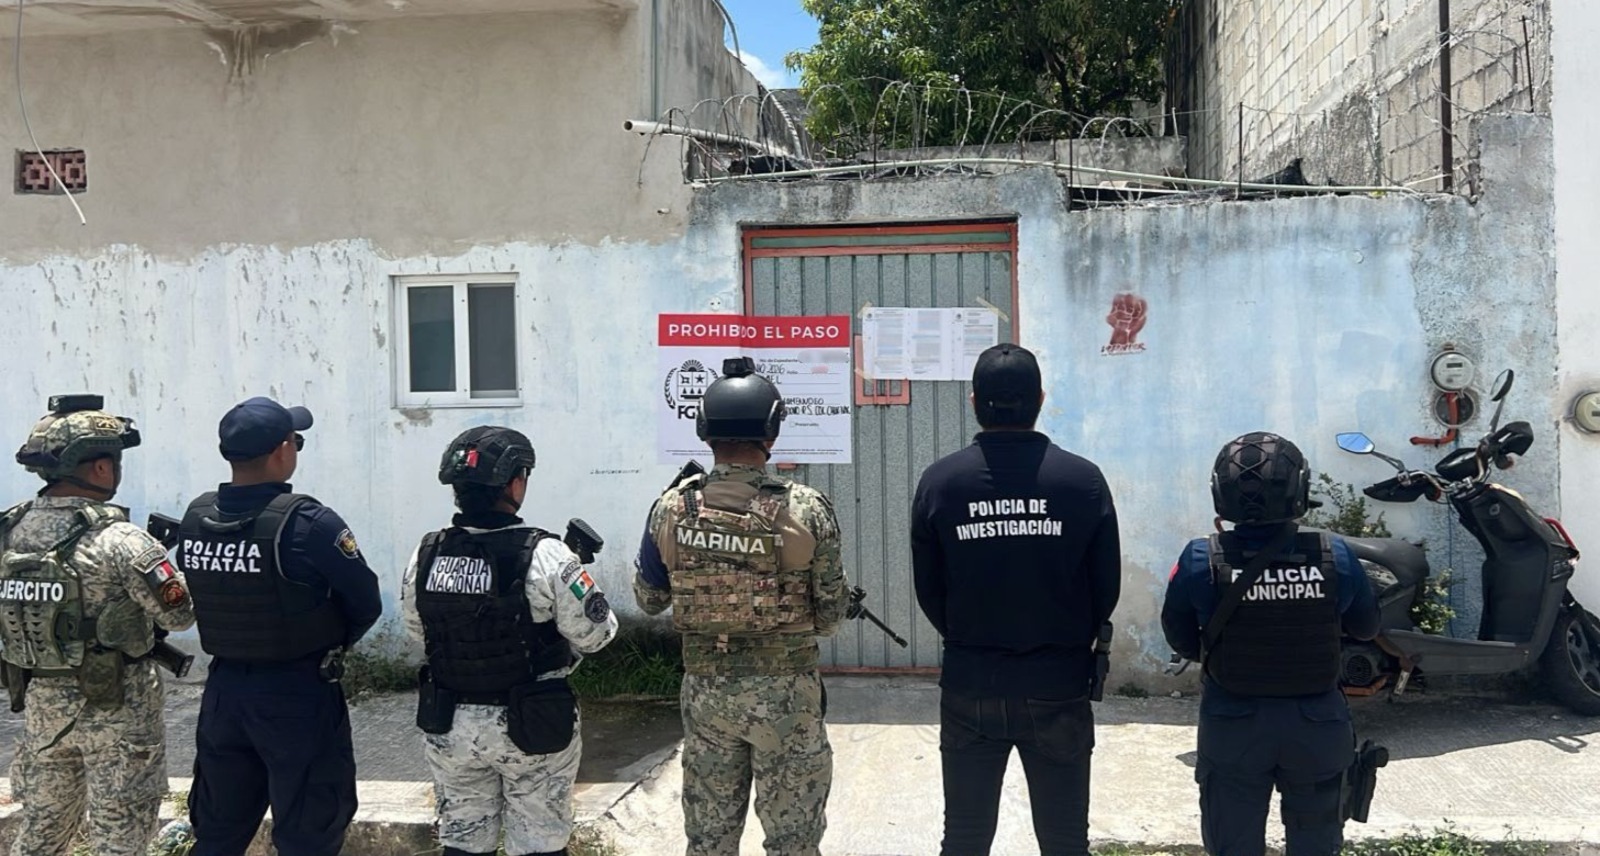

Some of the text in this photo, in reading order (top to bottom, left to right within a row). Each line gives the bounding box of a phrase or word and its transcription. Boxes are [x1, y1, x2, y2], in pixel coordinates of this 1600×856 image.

[669, 324, 839, 339] PROHIBDO EL PASO
[678, 405, 699, 419] FG
[1029, 499, 1047, 514] DE
[956, 518, 1062, 540] INVESTIGACIÓN
[184, 539, 261, 558] POLICÍA
[677, 527, 766, 554] MARINA
[184, 555, 261, 573] ESTATAL
[436, 557, 489, 576] GUARDIA
[429, 573, 490, 593] NACIONAL
[1231, 566, 1325, 583] PLICÍA
[1242, 583, 1325, 601] UNICIPAL
